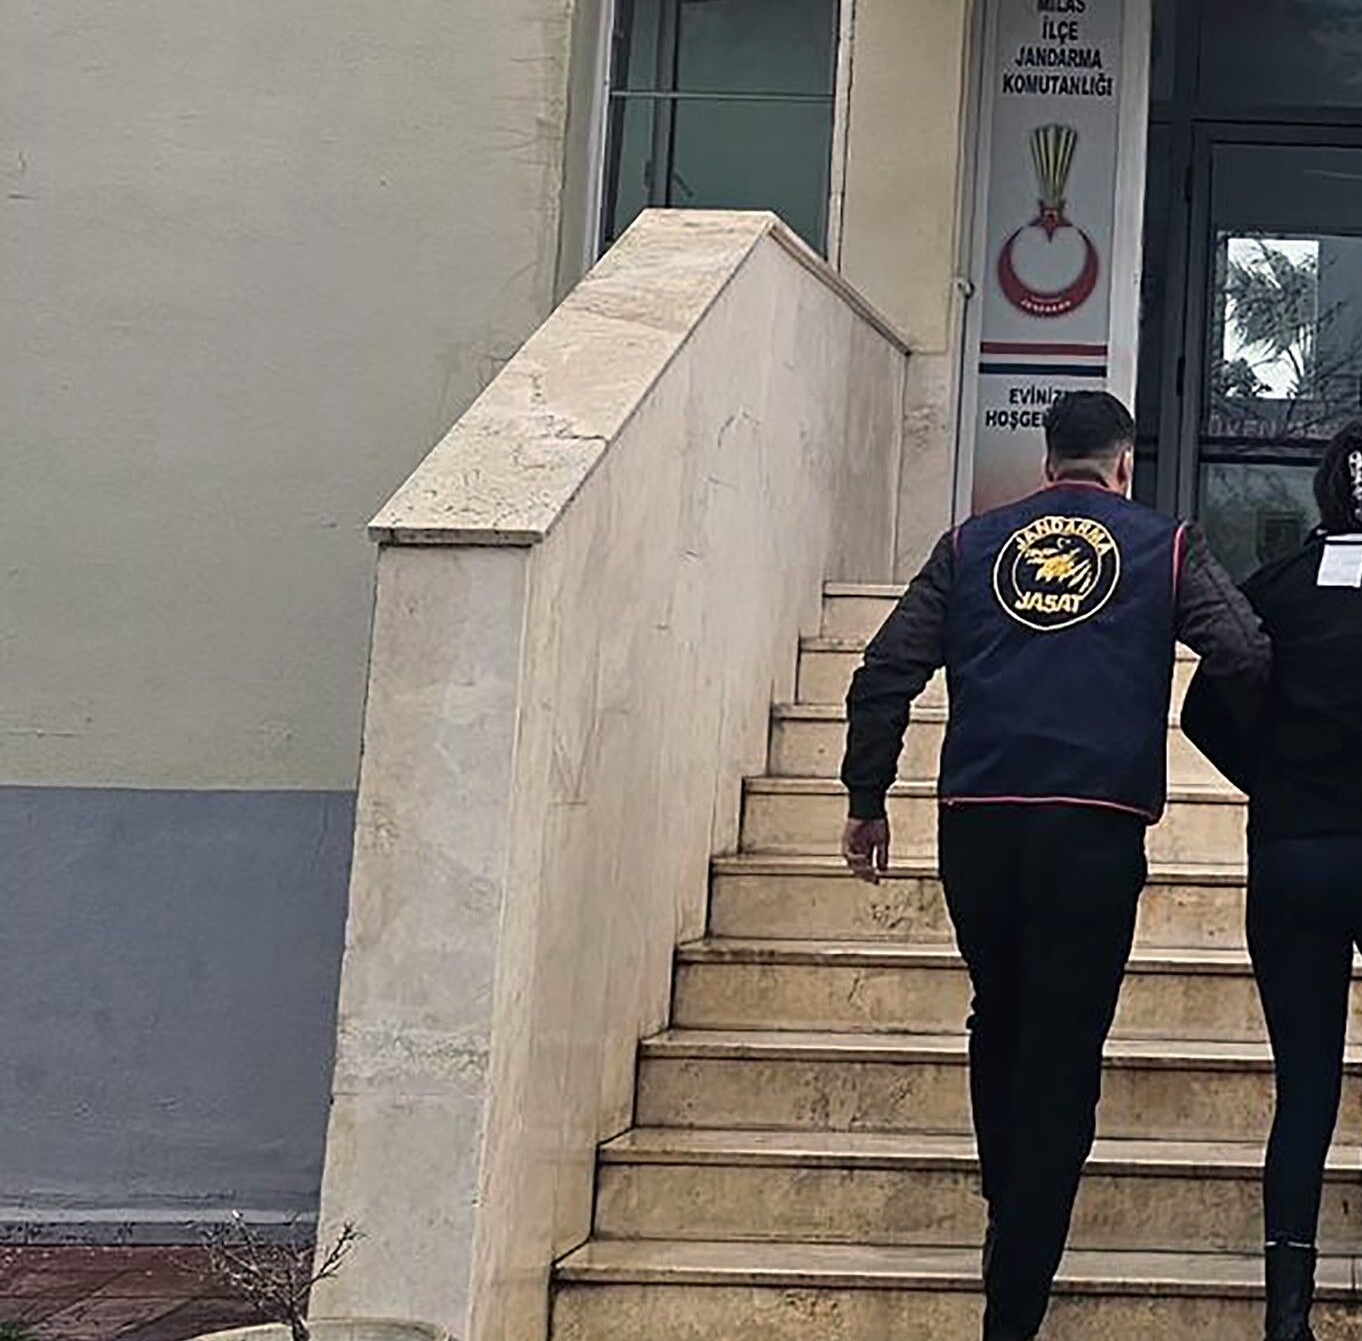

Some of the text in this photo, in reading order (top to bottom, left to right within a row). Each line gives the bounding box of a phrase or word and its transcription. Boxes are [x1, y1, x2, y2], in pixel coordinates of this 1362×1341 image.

[1042, 15, 1079, 45] İLÇE
[1014, 45, 1103, 70] JANDARMA
[1002, 73, 1114, 97] KOMUTANLIĞI
[1015, 517, 1115, 556] JANDARMA
[1013, 590, 1085, 614] JASAT
